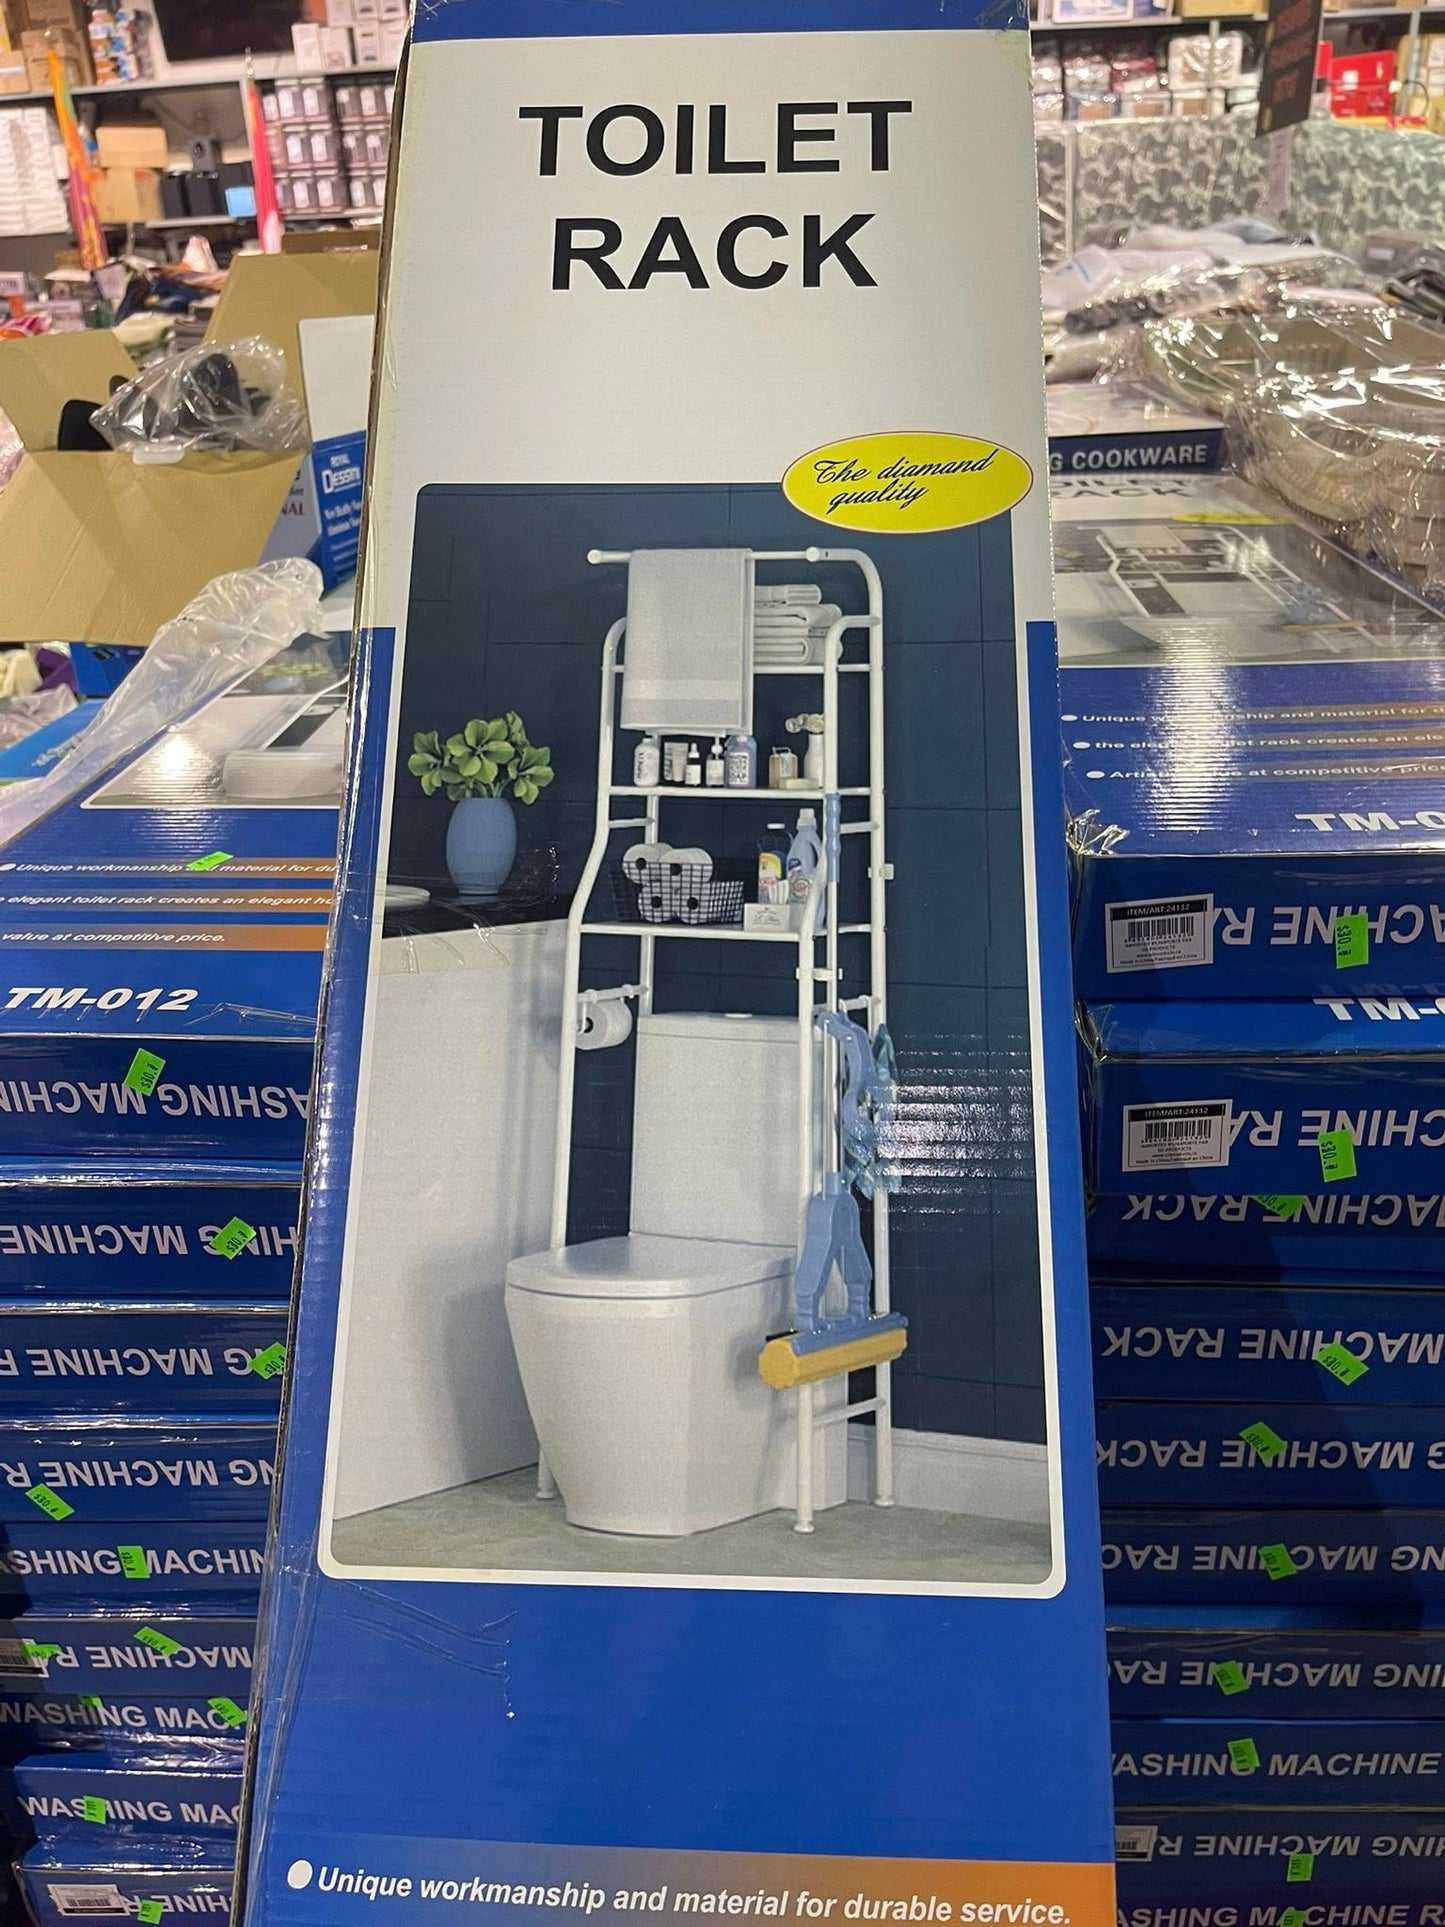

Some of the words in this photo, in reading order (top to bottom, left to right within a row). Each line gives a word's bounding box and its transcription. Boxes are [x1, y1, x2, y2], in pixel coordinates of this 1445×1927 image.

[518, 100, 912, 177] TOILET
[551, 213, 879, 291] RACK
[1071, 444, 1208, 470] COOKWARE
[814, 459, 871, 485] The
[826, 478, 930, 516] quality
[1082, 715, 1146, 723] Unique
[1280, 710, 1315, 719] and
[1320, 708, 1395, 718] material
[1401, 707, 1428, 715] for
[1094, 741, 1125, 749] the
[1259, 738, 1301, 746] rack
[1306, 736, 1378, 745] creates
[1384, 734, 1408, 742] an
[1249, 768, 1268, 777] at
[1273, 765, 1393, 778] competitive
[16, 863, 74, 873] Unique
[76, 863, 182, 874] workmanship
[219, 864, 286, 873] material
[287, 864, 313, 873] for
[8, 895, 72, 906] elegant
[71, 896, 117, 905] toilet
[116, 896, 154, 905] rack
[157, 896, 220, 905] creates
[223, 897, 245, 905] an
[248, 896, 312, 907] elegant
[2, 931, 50, 942] value
[52, 933, 73, 942] at
[72, 931, 175, 944] competitive
[174, 933, 226, 944] price.
[4, 987, 199, 1012] TM-012
[1121, 1195, 1250, 1222] RACK
[0, 1224, 188, 1255] MACHINE
[1102, 1326, 1225, 1359] RACK
[26, 1348, 214, 1376] MACHINE
[1095, 1439, 1207, 1467] RACK
[38, 1460, 219, 1487] MACHINE
[1268, 1752, 1442, 1777] MACHINE
[1194, 1835, 1361, 1857] MACHINE
[317, 1866, 412, 1901] Unique
[420, 1876, 606, 1915] workmanship
[612, 1886, 668, 1912] and
[672, 1889, 789, 1917] material
[795, 1891, 838, 1919] for
[844, 1893, 952, 1923] durable
[960, 1899, 1072, 1926] service.
